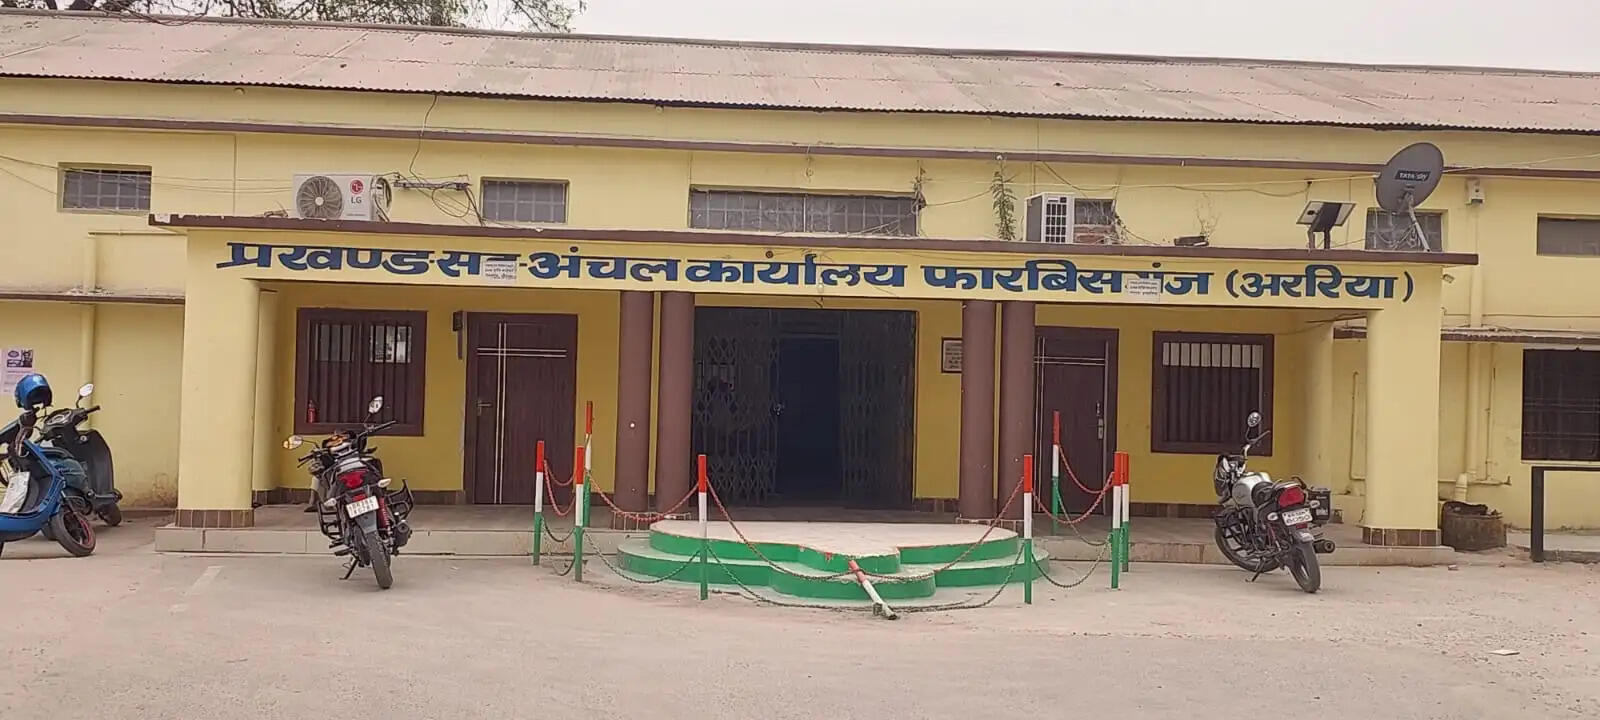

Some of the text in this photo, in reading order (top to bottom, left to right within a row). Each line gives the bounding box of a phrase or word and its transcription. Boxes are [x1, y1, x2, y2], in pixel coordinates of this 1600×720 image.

[216, 242, 681, 281] प्रखण्ड-स-अंचल
[685, 253, 908, 287] कार्यालय
[1226, 264, 1413, 303] (अररिया)
